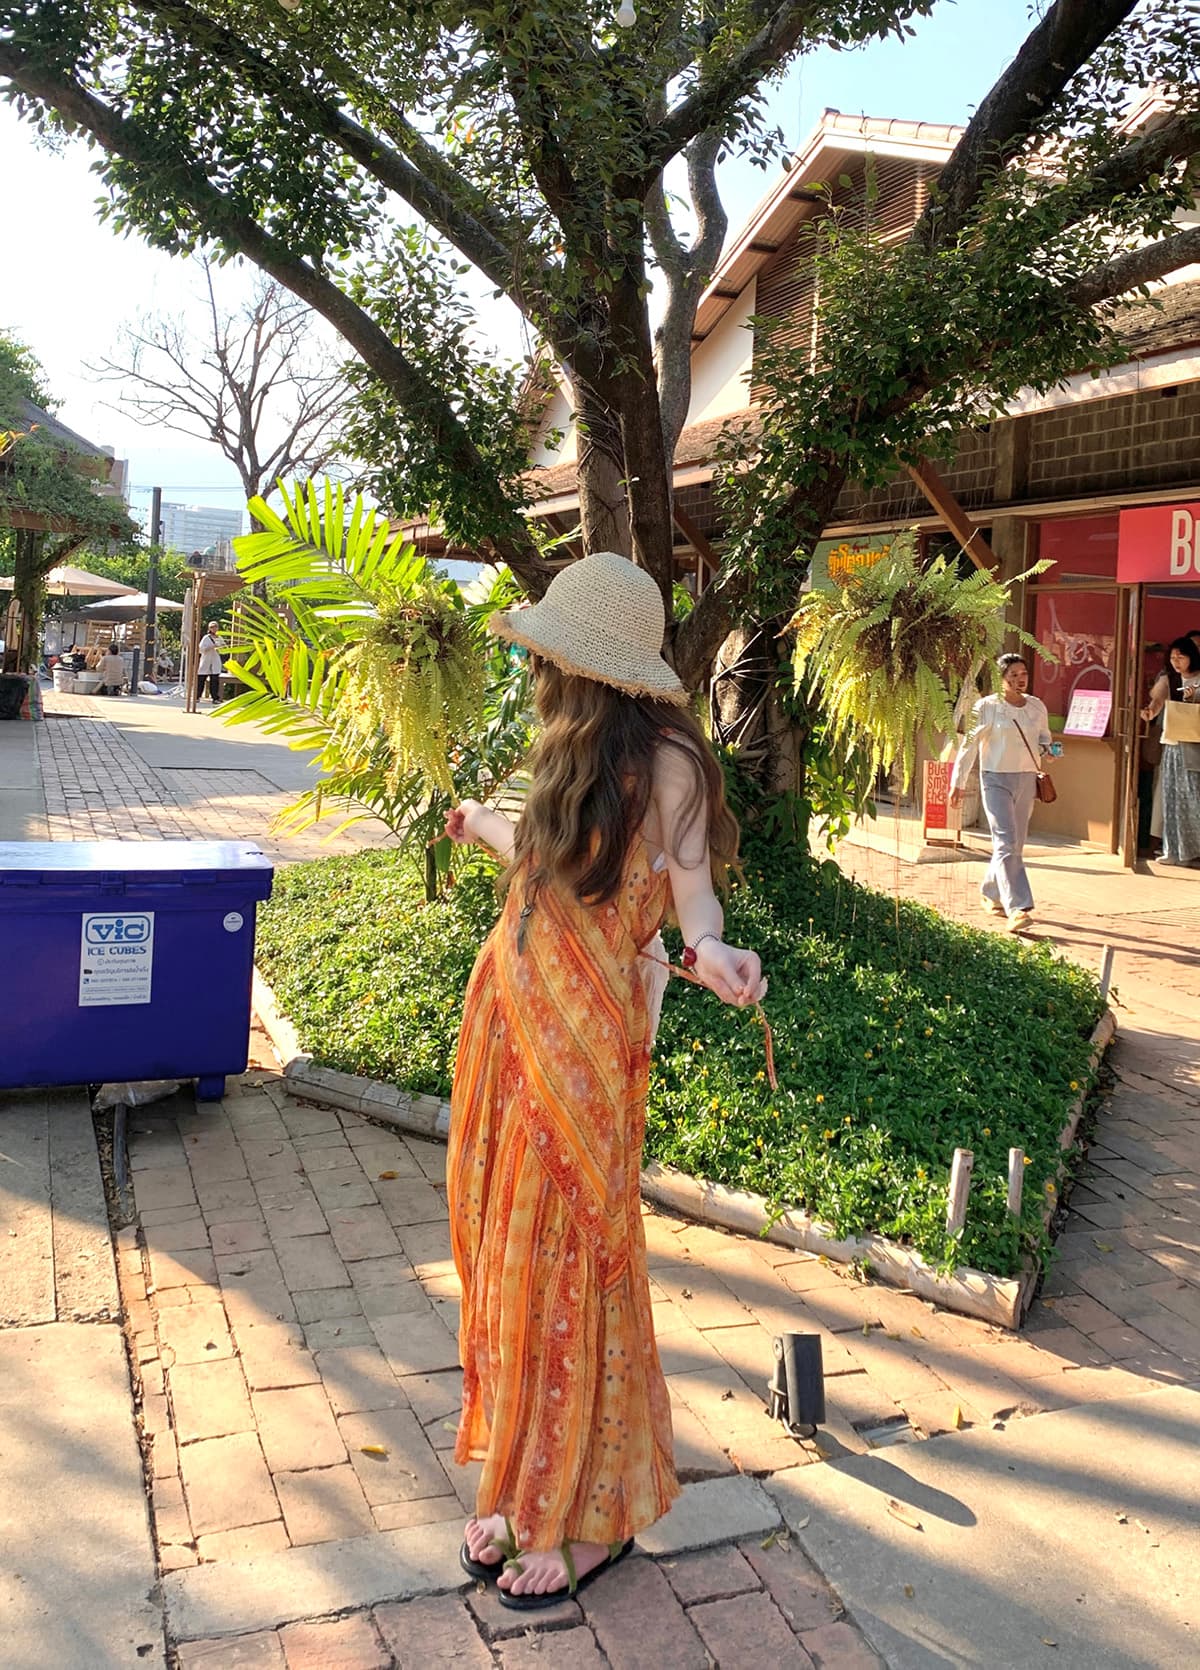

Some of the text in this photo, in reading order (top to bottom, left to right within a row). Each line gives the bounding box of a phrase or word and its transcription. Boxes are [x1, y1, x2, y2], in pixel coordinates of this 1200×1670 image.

[1170, 509, 1200, 577] B
[87, 945, 147, 956] ICE CUBES
